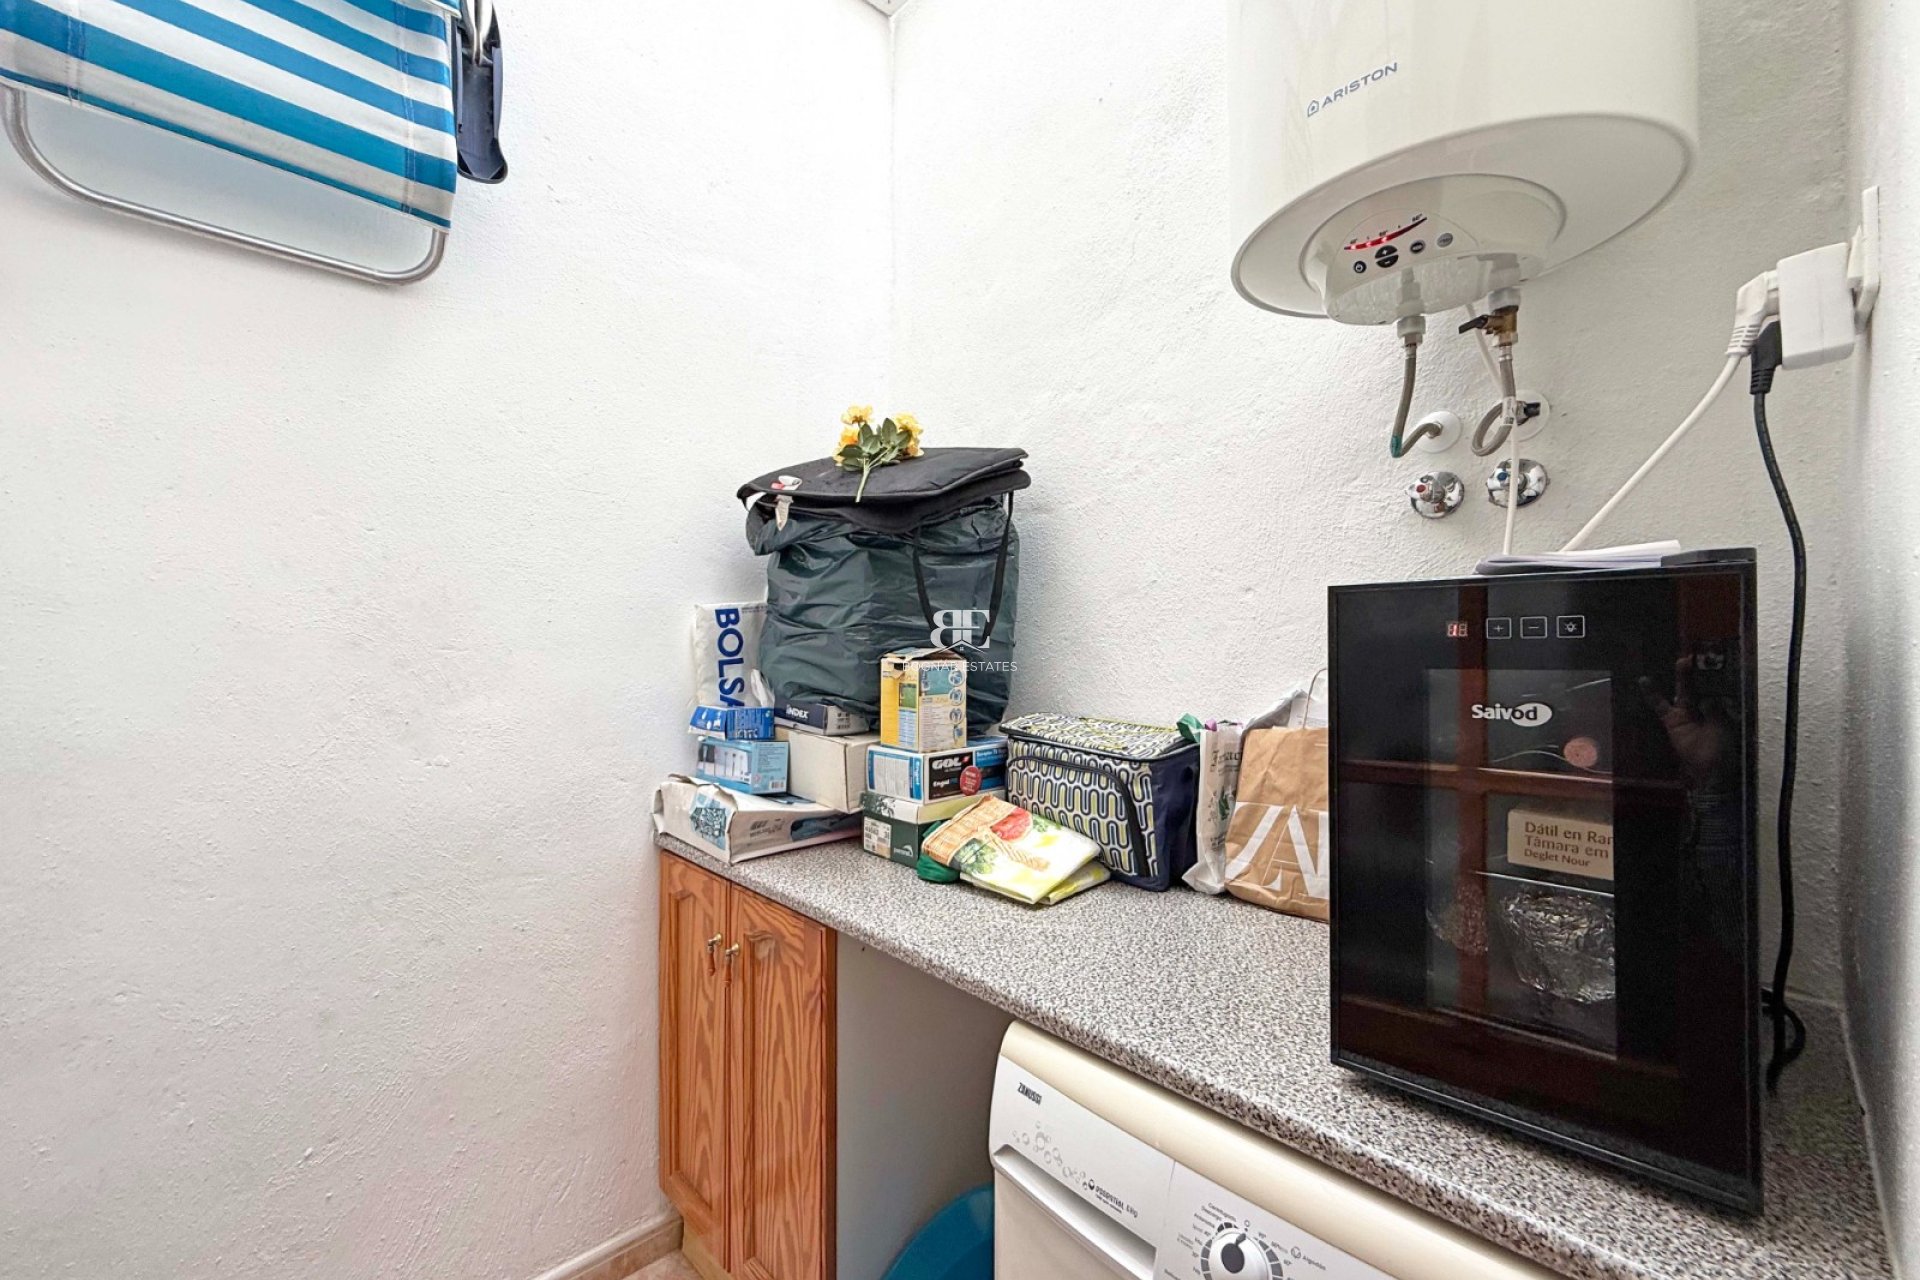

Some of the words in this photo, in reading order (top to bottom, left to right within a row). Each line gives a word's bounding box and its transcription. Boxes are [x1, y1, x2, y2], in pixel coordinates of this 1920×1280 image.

[1322, 62, 1398, 108] ARISTON
[1471, 703, 1538, 721] Saivod
[931, 757, 962, 770] GOL
[1524, 821, 1559, 837] Dátil
[1563, 829, 1582, 840] en
[1524, 848, 1559, 862] Deglet
[1561, 854, 1591, 867] Nour
[1584, 845, 1609, 859] em
